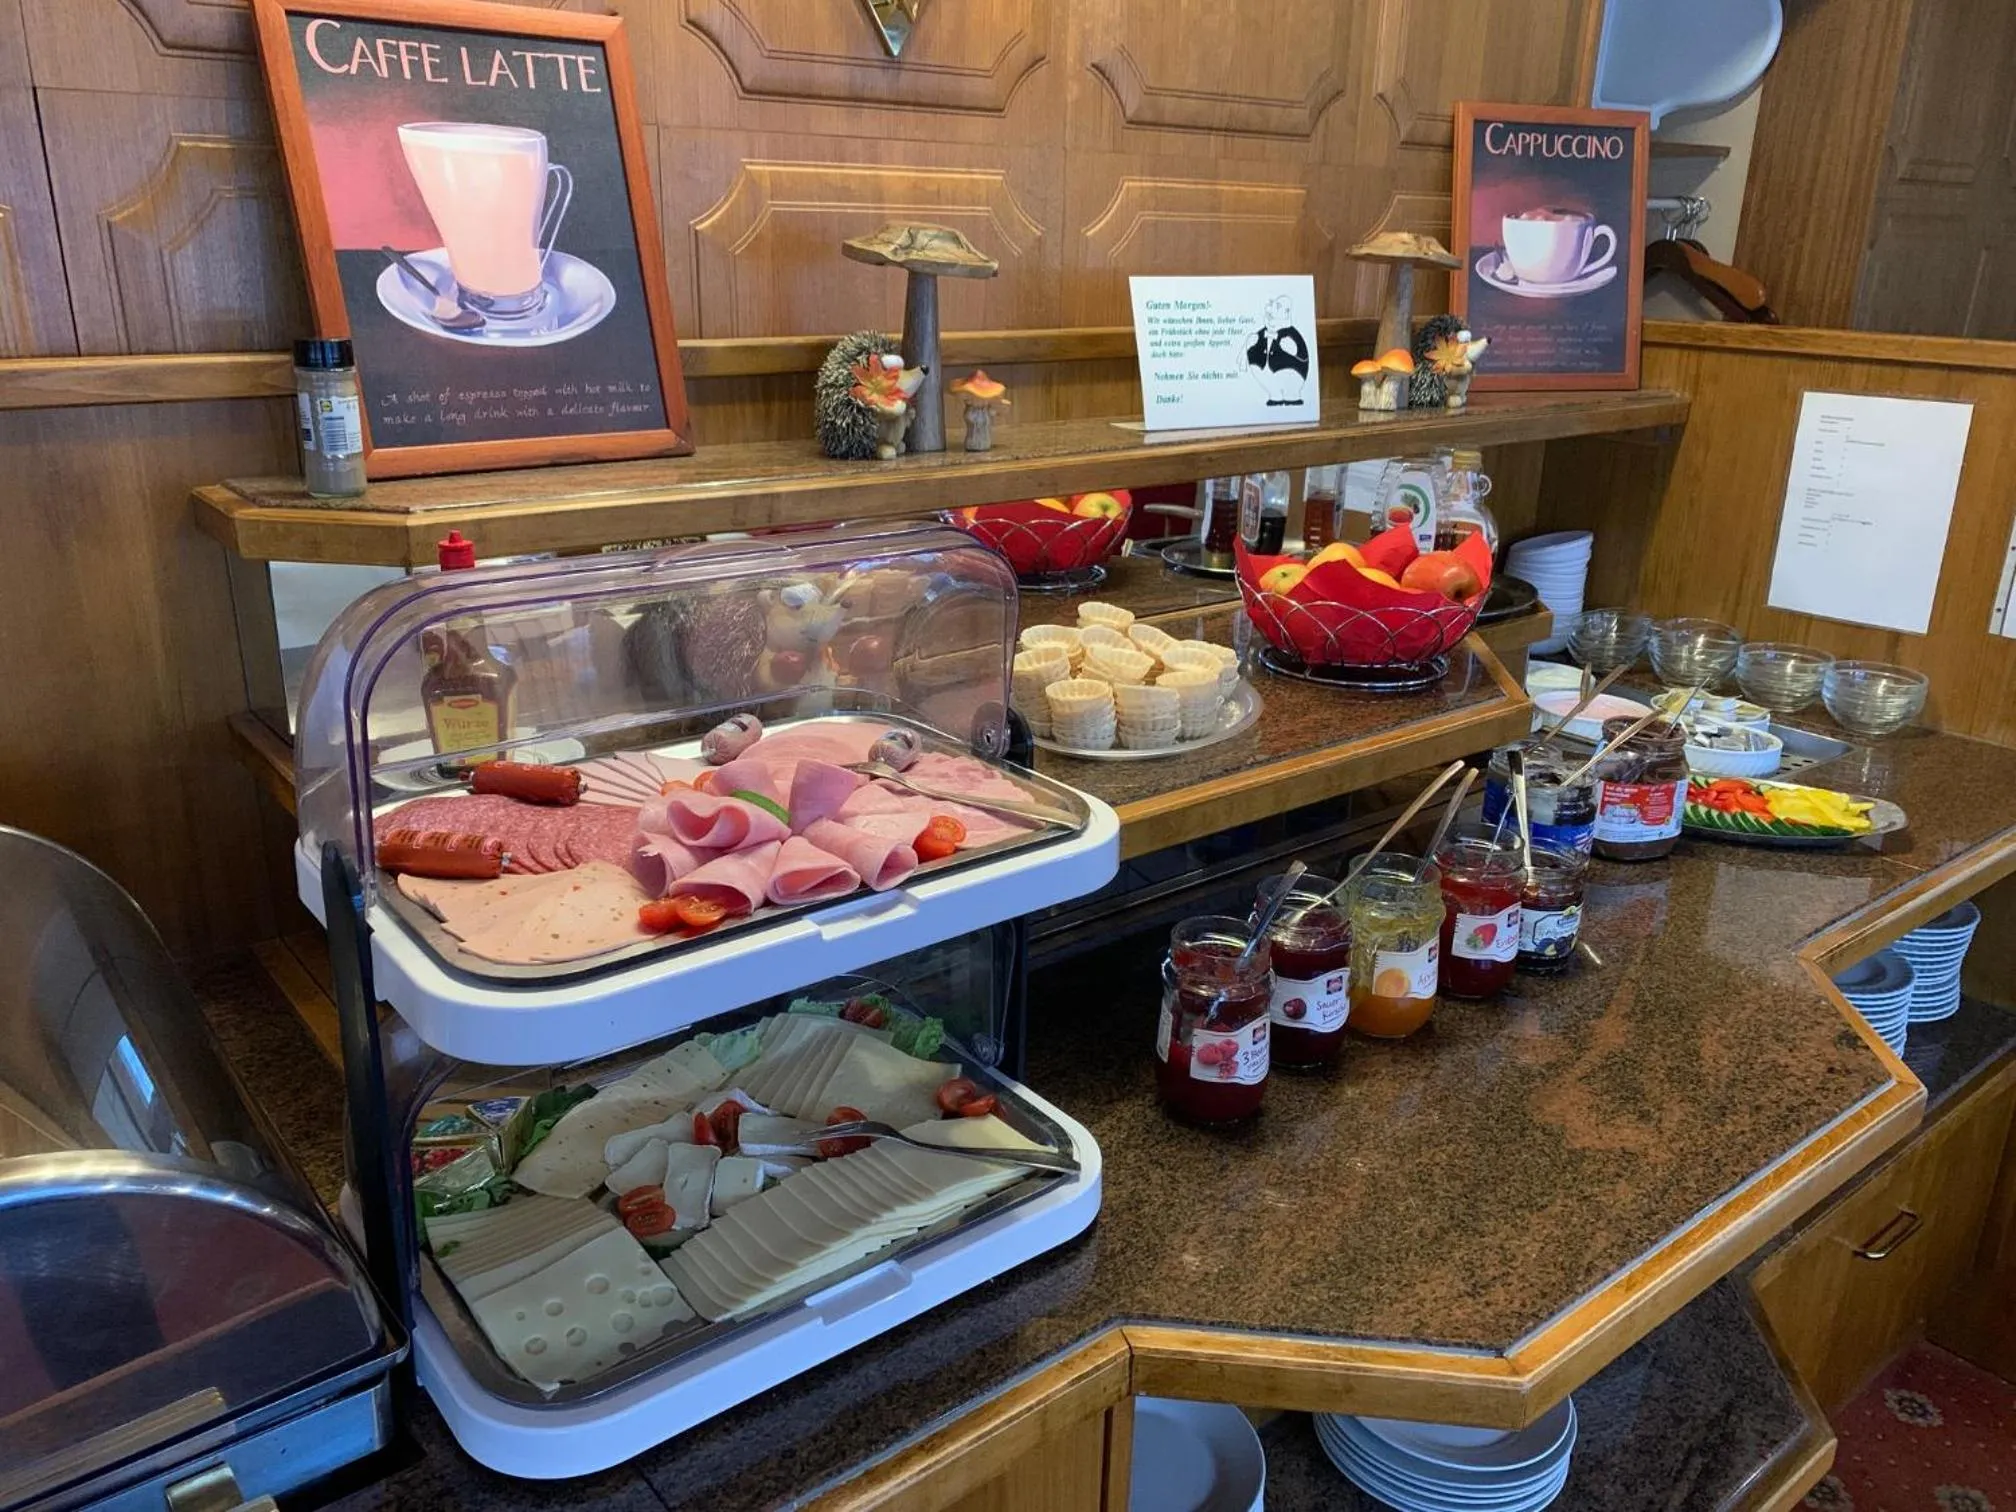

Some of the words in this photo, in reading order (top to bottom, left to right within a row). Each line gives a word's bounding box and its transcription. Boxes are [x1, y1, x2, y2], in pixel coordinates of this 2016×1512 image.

[305, 19, 448, 84] CAFFE
[460, 46, 602, 93] LATTE
[1484, 122, 1624, 160] CAPPUCCINO
[1145, 300, 1171, 310] Guten
[439, 386, 450, 405] of
[382, 412, 417, 424] make
[440, 408, 466, 426] long
